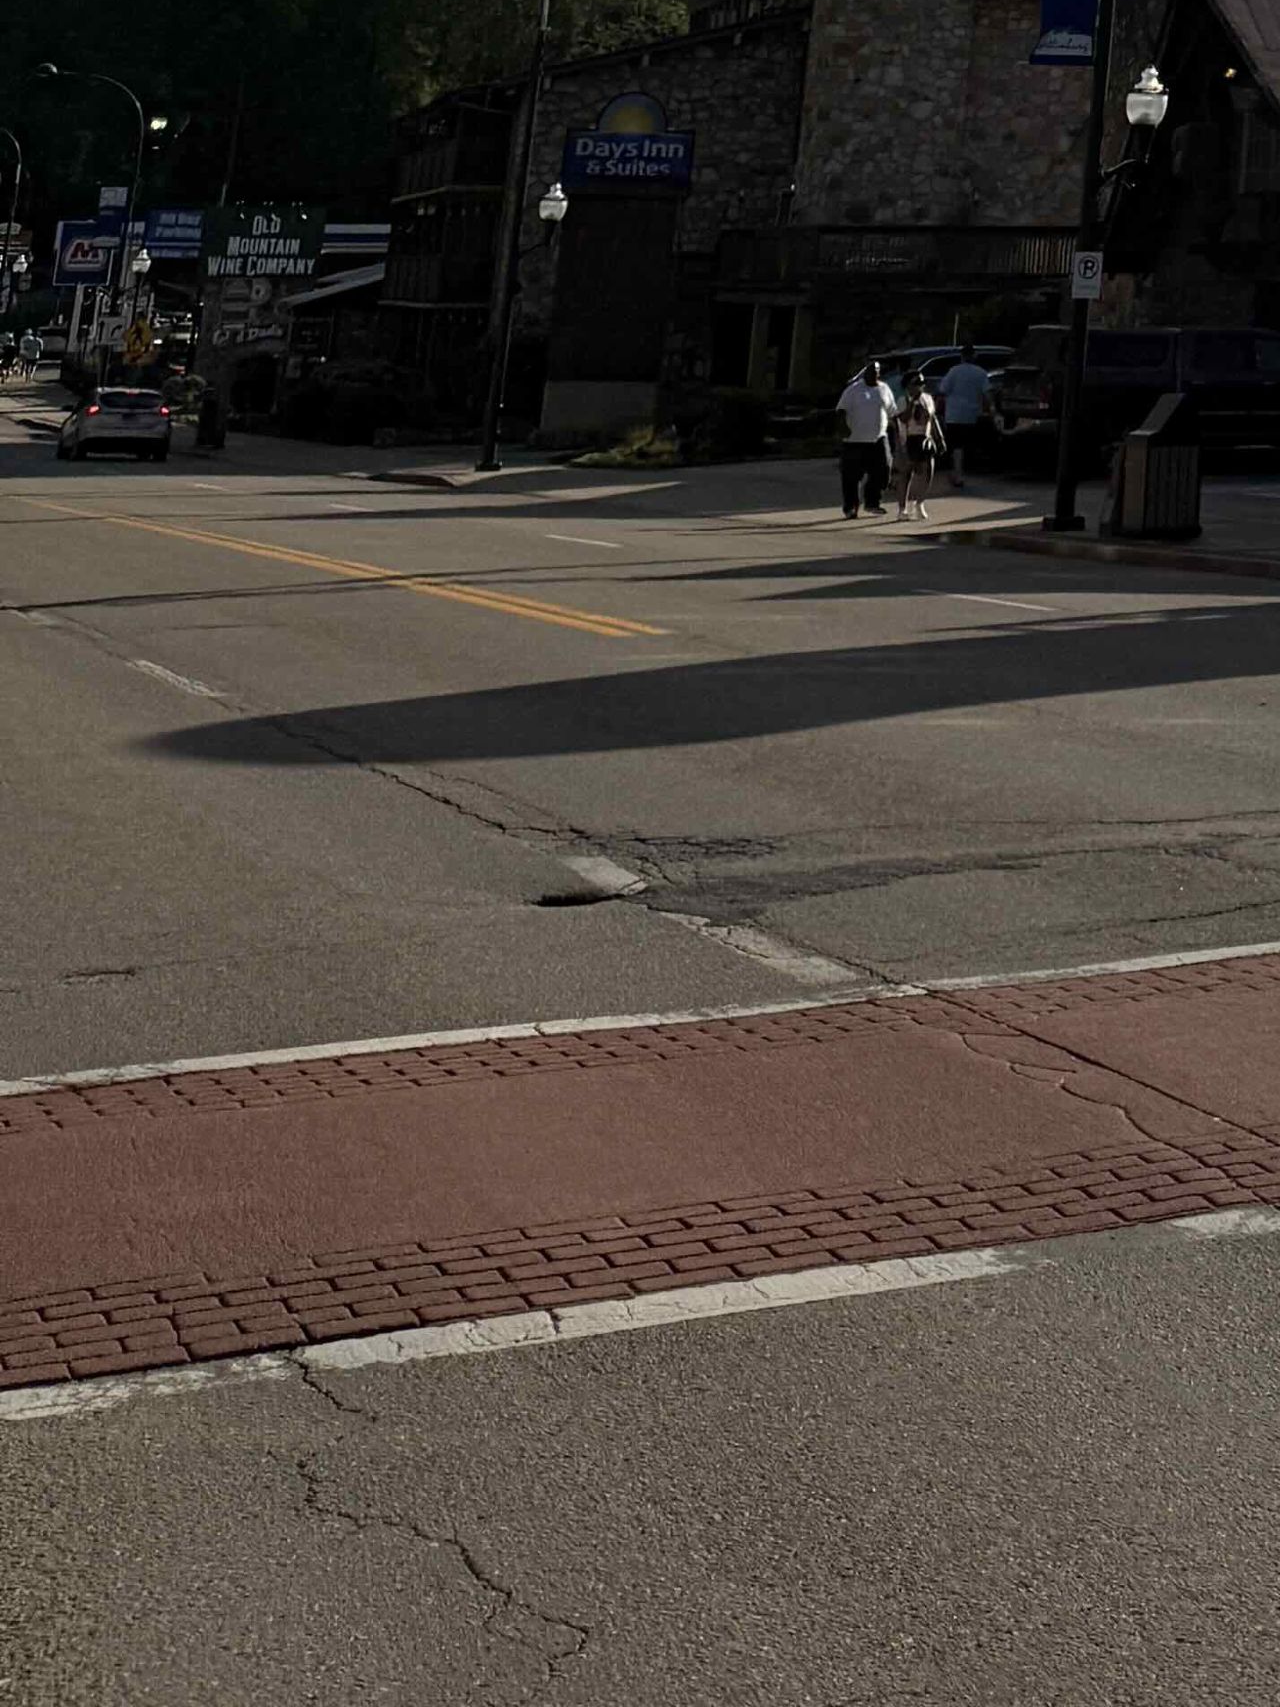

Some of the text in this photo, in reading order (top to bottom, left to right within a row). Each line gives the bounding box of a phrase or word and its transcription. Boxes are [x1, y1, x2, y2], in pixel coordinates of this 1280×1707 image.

[574, 137, 685, 160] Days Inn
[585, 159, 672, 177] & Suites
[252, 213, 282, 237] OLD
[226, 237, 301, 257] MOUNTAIN
[207, 255, 316, 278] WINE COMPANY
